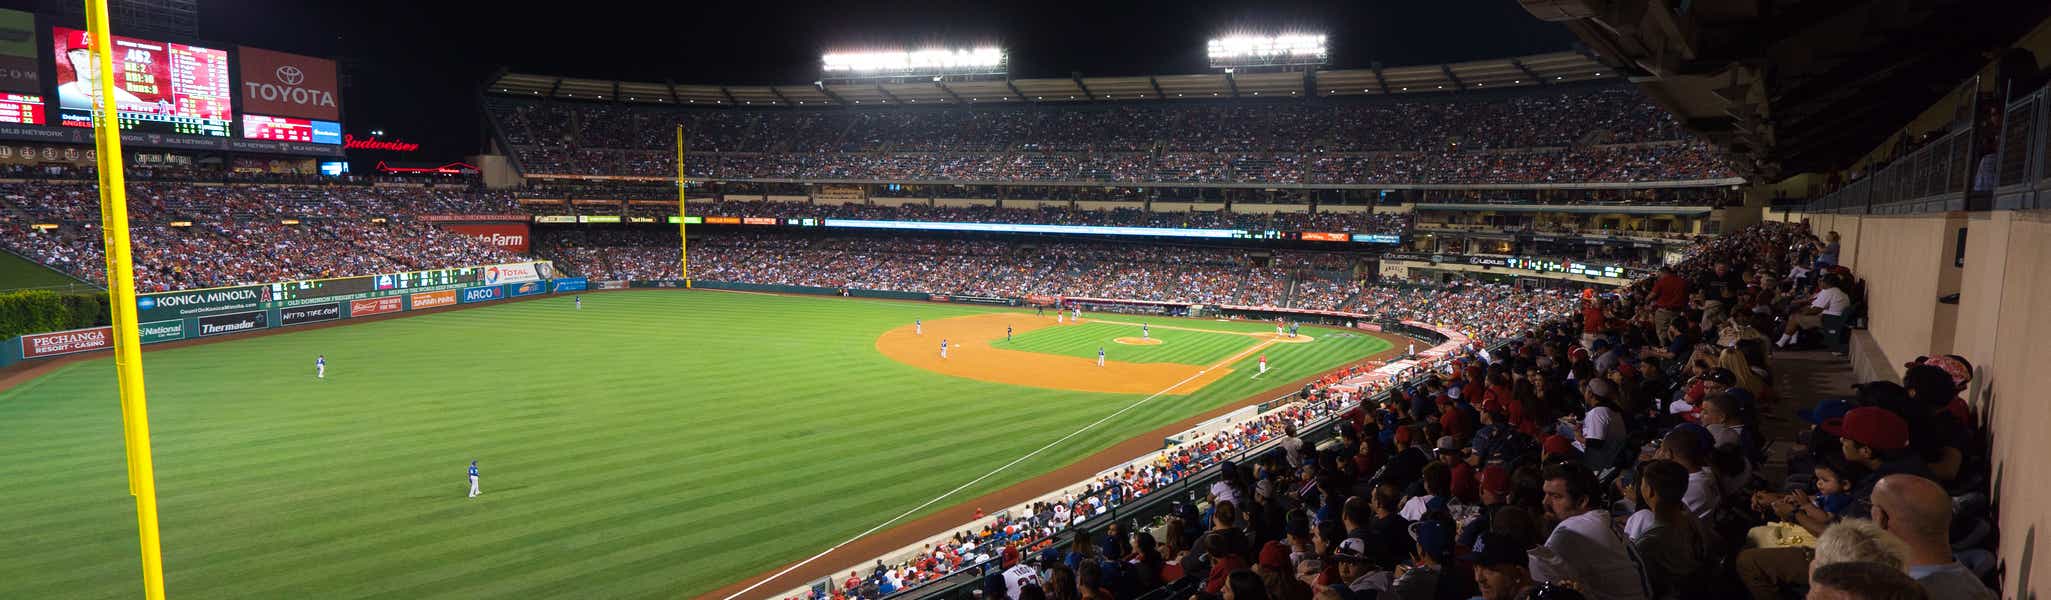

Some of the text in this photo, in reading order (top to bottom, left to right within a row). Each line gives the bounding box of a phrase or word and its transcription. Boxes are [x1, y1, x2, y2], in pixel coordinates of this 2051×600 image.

[245, 81, 336, 107] TOYOTA
[61, 113, 91, 123] Dodgers
[61, 120, 92, 129] ANGELS
[1, 128, 63, 139] MLB NETWORK
[344, 134, 420, 151] Budweiser
[134, 152, 163, 164] Captain
[492, 233, 523, 246] Farm
[502, 268, 528, 277] TOTAL
[156, 294, 206, 307] KONICA
[207, 289, 257, 303] MINOLTA
[466, 288, 493, 301] ARCO
[283, 307, 338, 320] NITTO TIRE.COM
[145, 324, 182, 336] National
[202, 320, 255, 334] Thermador
[33, 331, 105, 347] PECHANGA
[35, 340, 105, 354] RESORT CASINO
